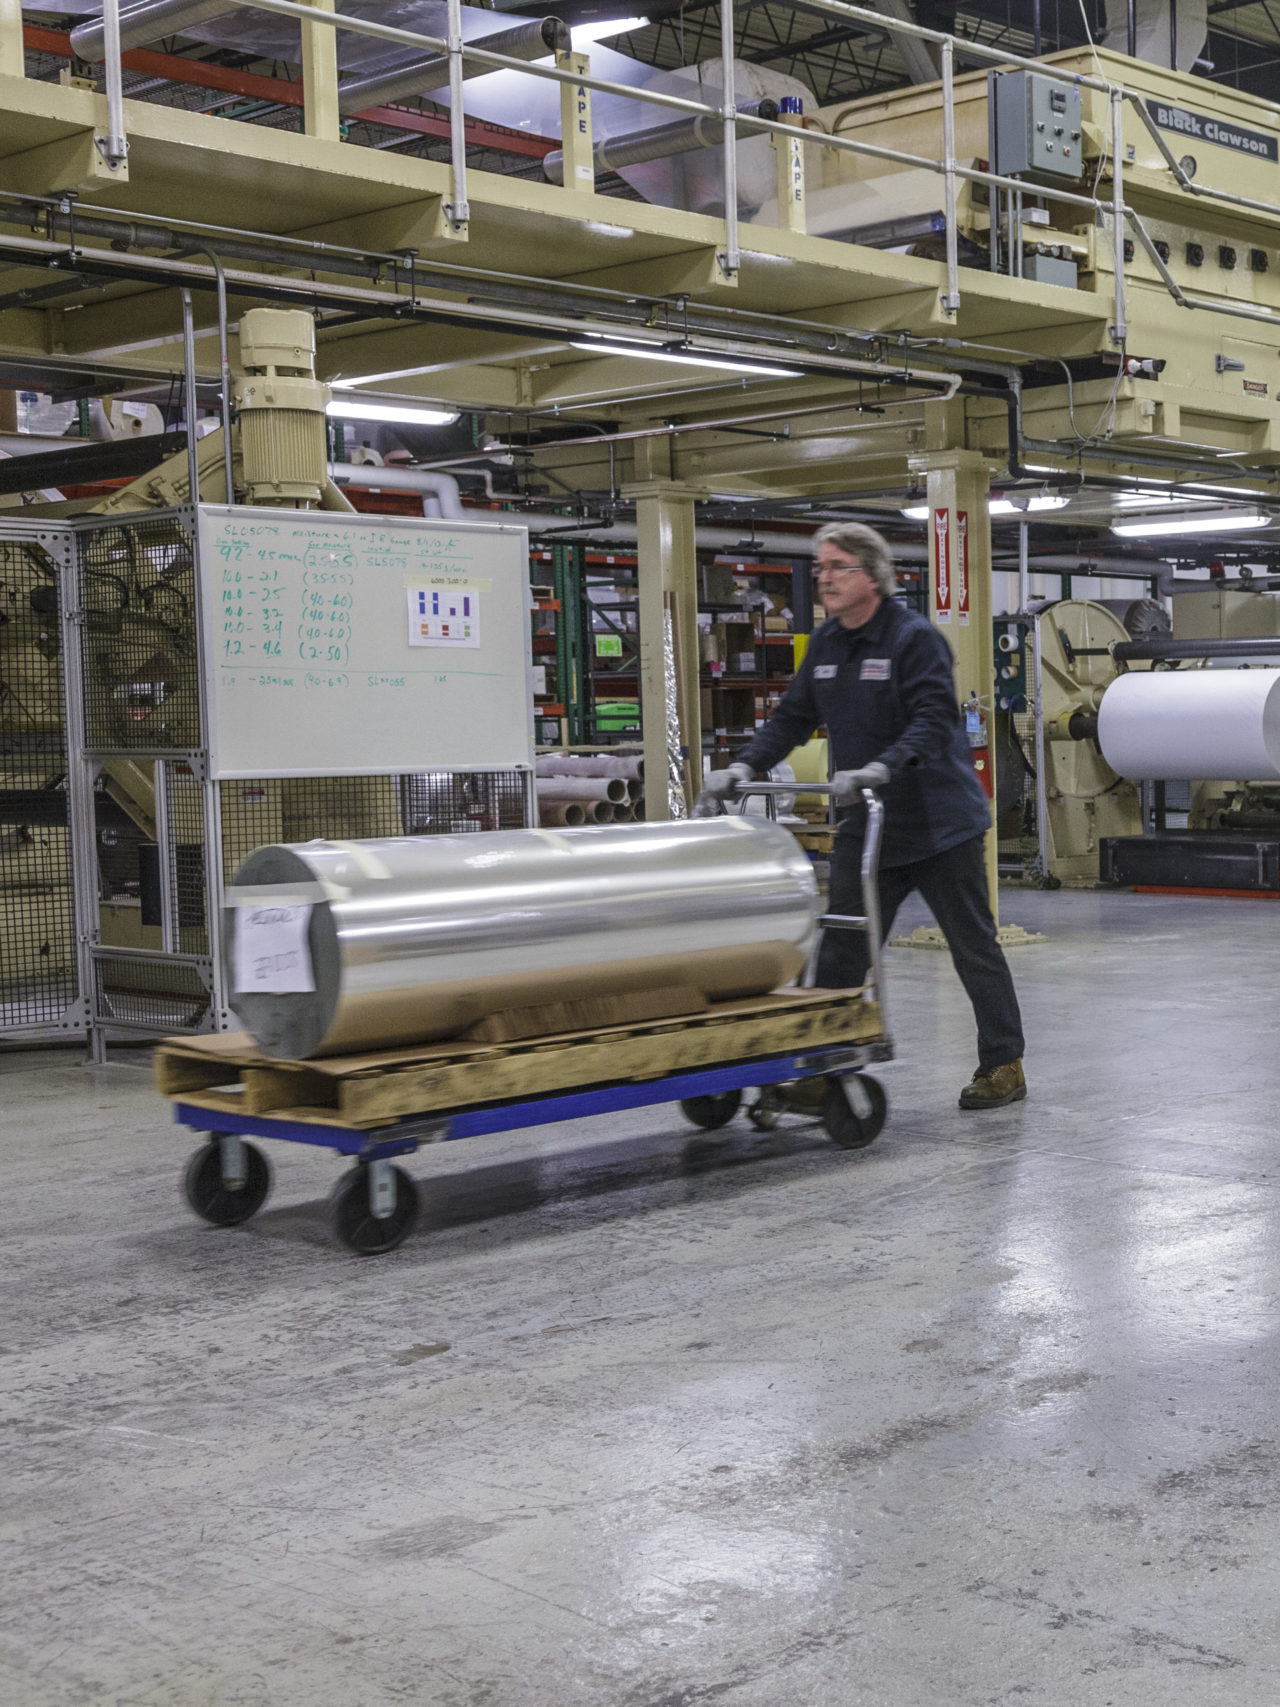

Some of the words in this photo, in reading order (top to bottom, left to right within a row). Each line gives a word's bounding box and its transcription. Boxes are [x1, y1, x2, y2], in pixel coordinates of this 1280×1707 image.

[577, 65, 586, 133] TAPE
[1157, 107, 1202, 136] Black
[1204, 122, 1268, 155] Clawson
[936, 522, 947, 530] FIRE
